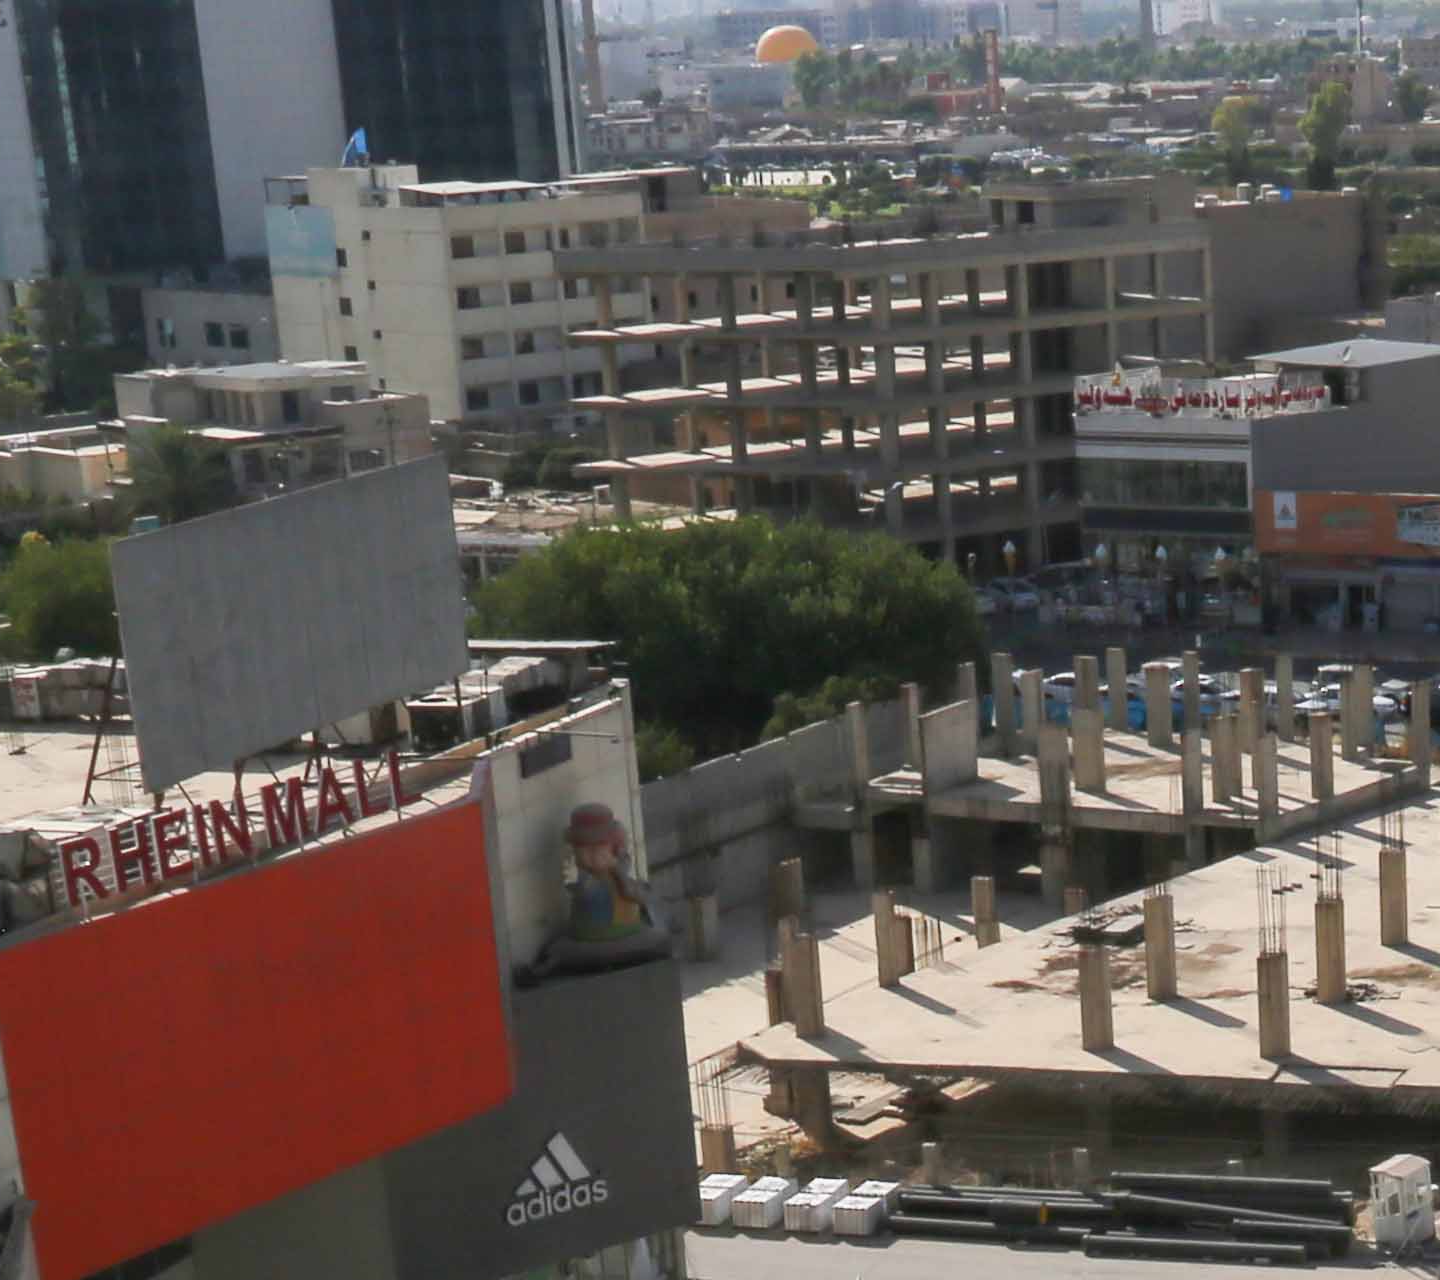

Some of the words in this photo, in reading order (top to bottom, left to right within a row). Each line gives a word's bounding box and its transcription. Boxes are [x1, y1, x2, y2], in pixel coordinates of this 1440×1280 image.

[59, 799, 256, 907] RHEIN
[260, 750, 422, 849] MALL
[506, 1178, 609, 1227] adidas
